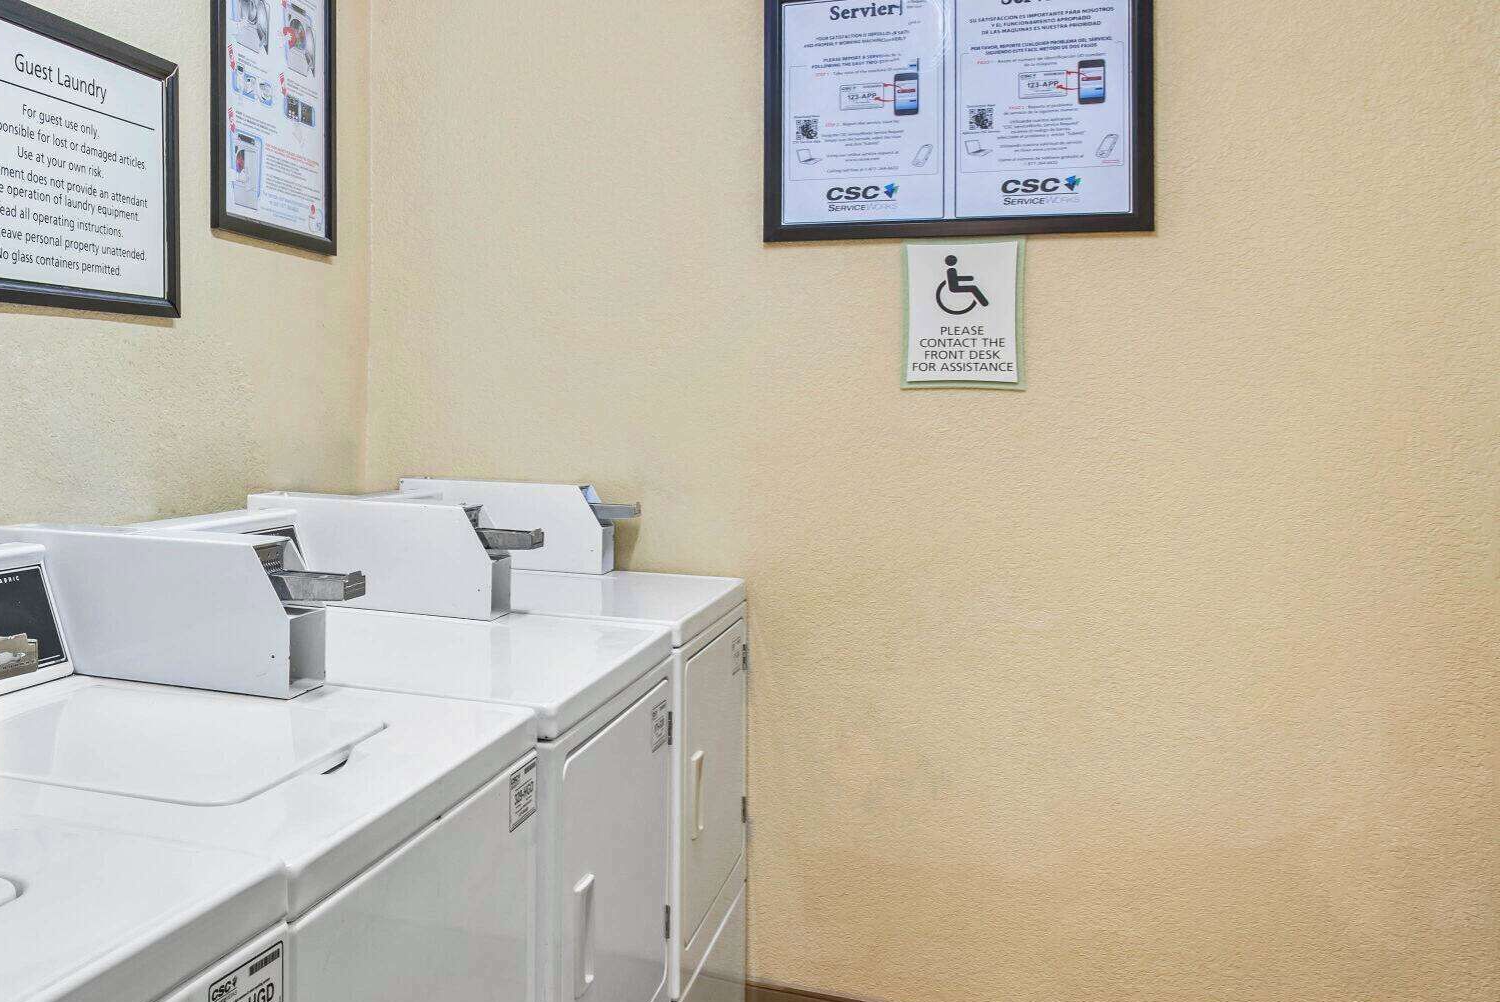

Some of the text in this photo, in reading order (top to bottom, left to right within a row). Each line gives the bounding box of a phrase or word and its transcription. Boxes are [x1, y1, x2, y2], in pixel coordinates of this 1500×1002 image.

[14, 53, 107, 104] Guest Laundry
[22, 103, 100, 140] For guest use only.
[37, 128, 50, 143] for
[52, 133, 68, 149] lost
[69, 141, 79, 151] or
[80, 142, 117, 162] damaged
[17, 145, 104, 179] Use at your own risk.
[26, 169, 48, 186] does
[50, 178, 65, 190] not
[66, 182, 97, 197] provide
[99, 189, 109, 199] an
[110, 192, 148, 209] attendant
[826, 185, 880, 201] CSC
[1001, 177, 1061, 194] CSC
[6, 185, 51, 203] operation
[53, 193, 62, 205] of
[64, 194, 95, 215] laundry
[97, 205, 140, 222] equipment.
[19, 207, 30, 220] all
[32, 212, 75, 232] operating
[76, 220, 124, 238] instructions.
[25, 232, 62, 247] personal
[64, 239, 100, 256] property
[101, 245, 147, 262] unattended.
[11, 249, 33, 265] glass
[35, 255, 80, 270] containers
[81, 262, 122, 277] permitted.
[919, 337, 1005, 348] CONTACT THE
[940, 325, 985, 336] PLEASE
[912, 362, 1013, 372] FOR ASSISTANCE
[924, 350, 1001, 360] FRONT DESK
[211, 981, 232, 1001] CSC
